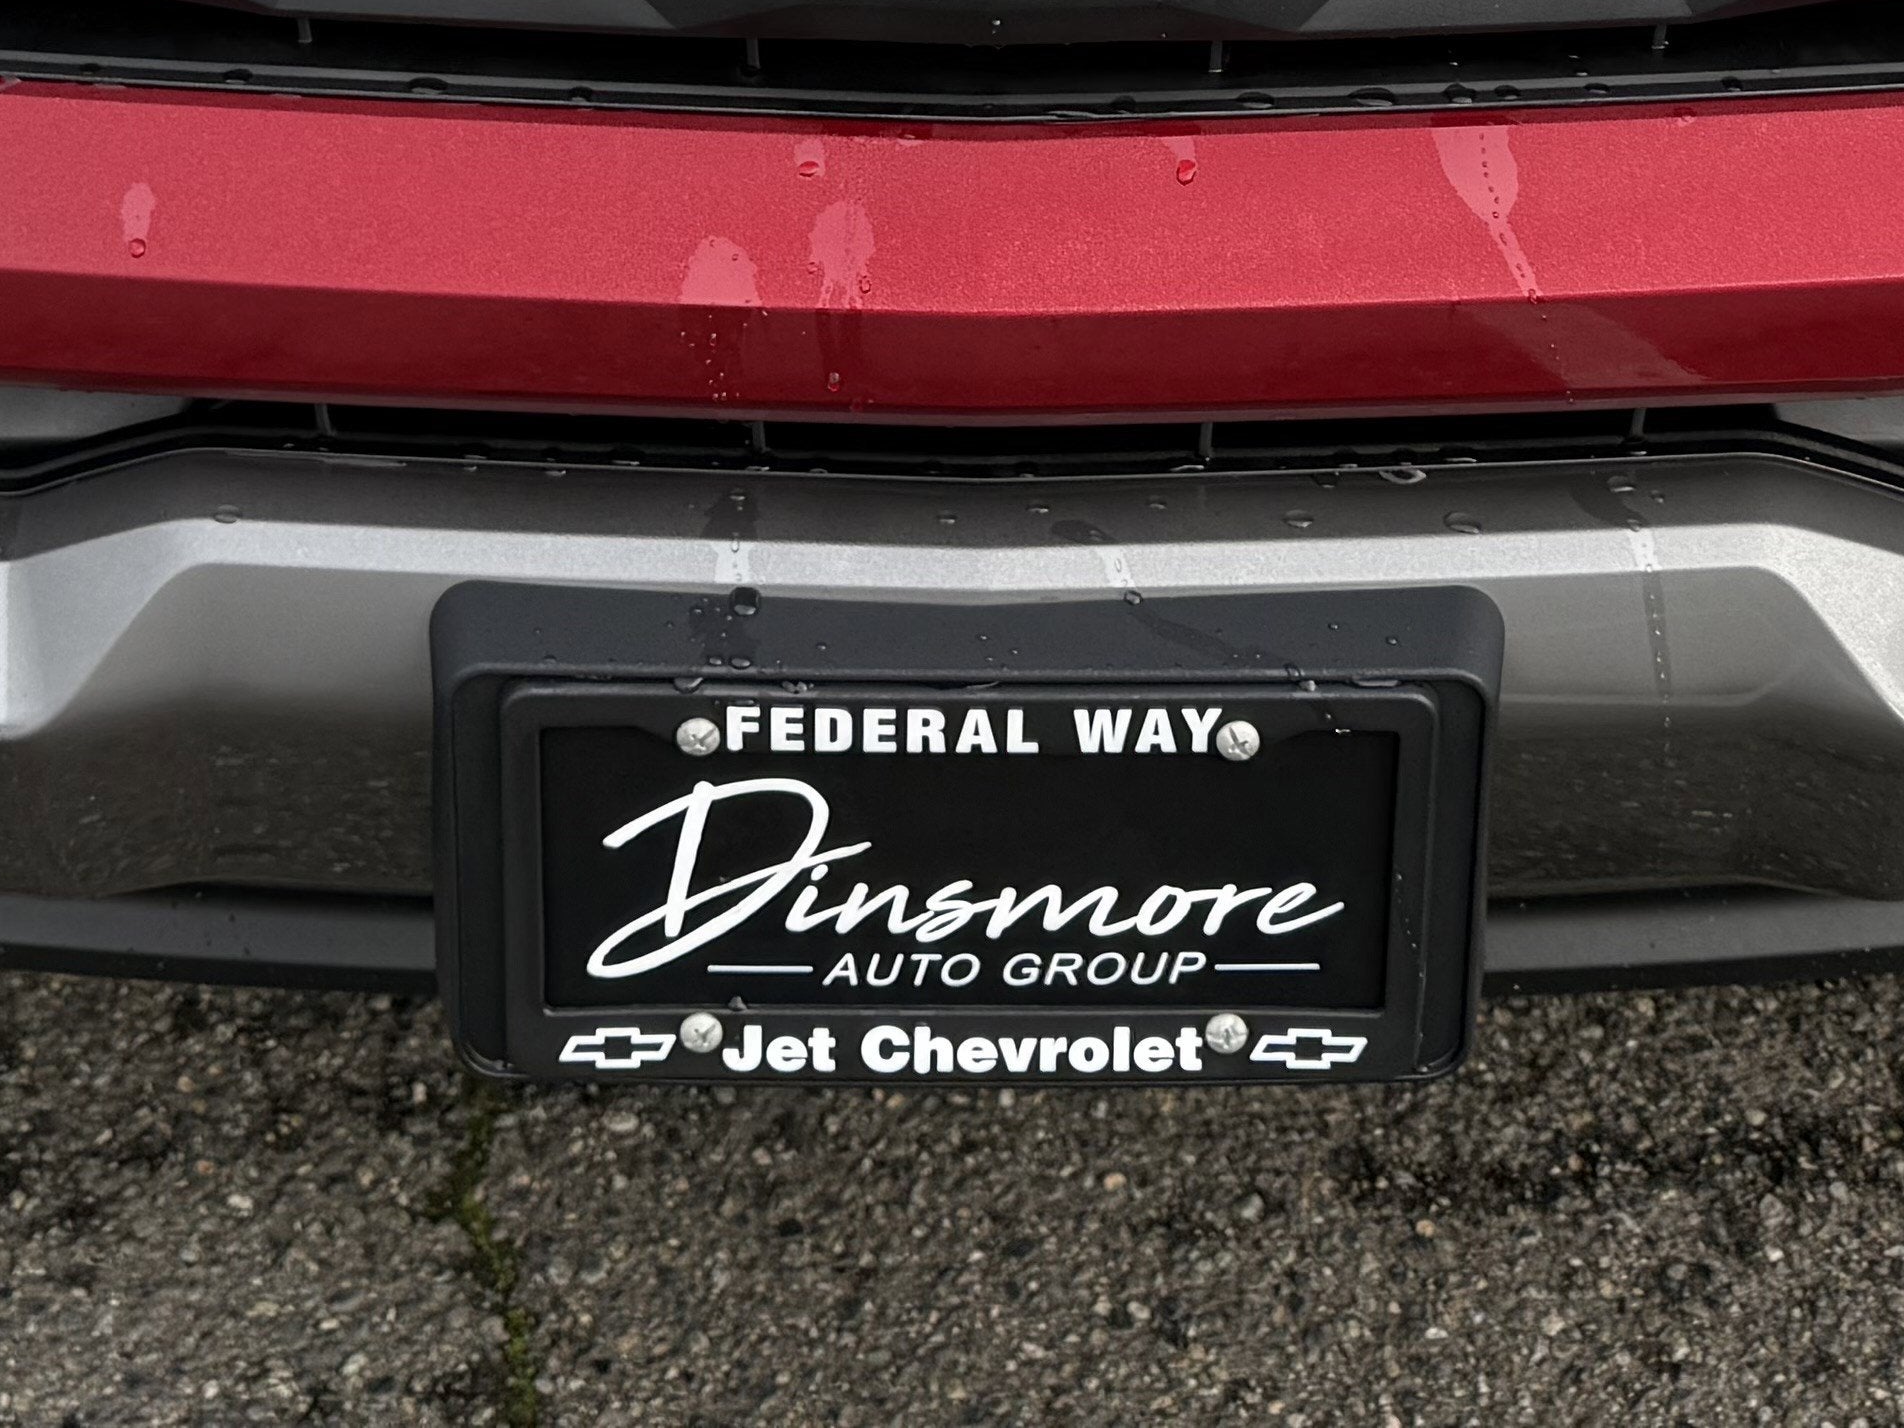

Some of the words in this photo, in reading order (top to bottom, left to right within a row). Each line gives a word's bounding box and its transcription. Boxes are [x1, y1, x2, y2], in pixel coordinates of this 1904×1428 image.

[725, 705, 1040, 755] FEDERAL
[1072, 706, 1225, 754] WAY
[585, 776, 1346, 980] Dinsmore
[821, 950, 983, 988] AUTO
[1001, 949, 1209, 988] GROUP
[721, 1023, 838, 1075] Jet
[858, 1022, 1205, 1076] Chevrolet
